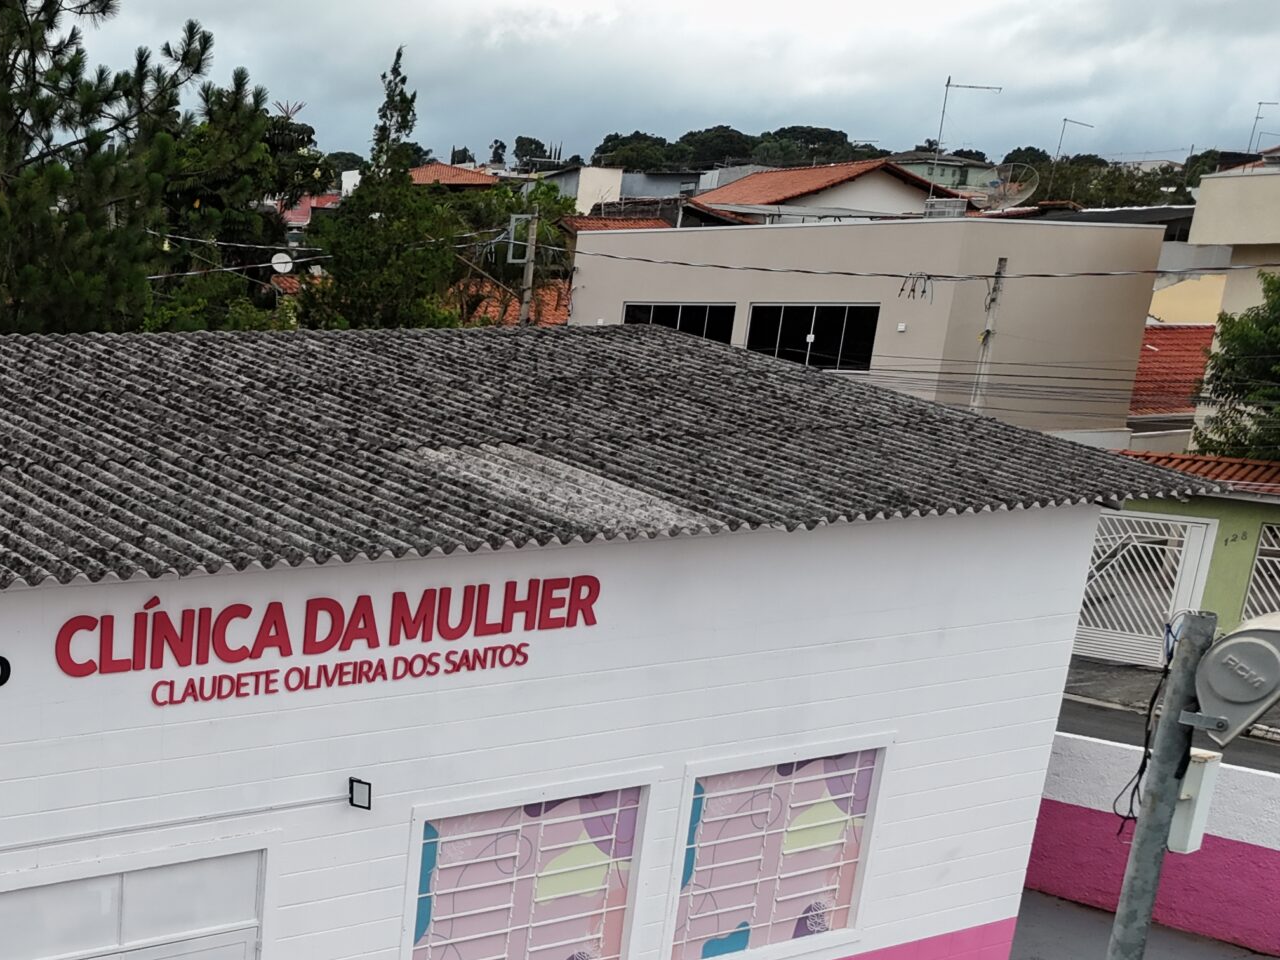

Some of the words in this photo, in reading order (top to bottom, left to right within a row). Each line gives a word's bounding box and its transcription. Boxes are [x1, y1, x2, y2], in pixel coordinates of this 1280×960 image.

[1224, 531, 1248, 547] 128
[55, 595, 293, 678] CLÍNICA
[303, 594, 381, 656] DA
[389, 575, 601, 647] MULHER
[151, 668, 279, 707] CLAUDETE
[284, 659, 388, 693] OLIVEIRA
[392, 650, 441, 681] DOS
[444, 642, 529, 674] SANTOS
